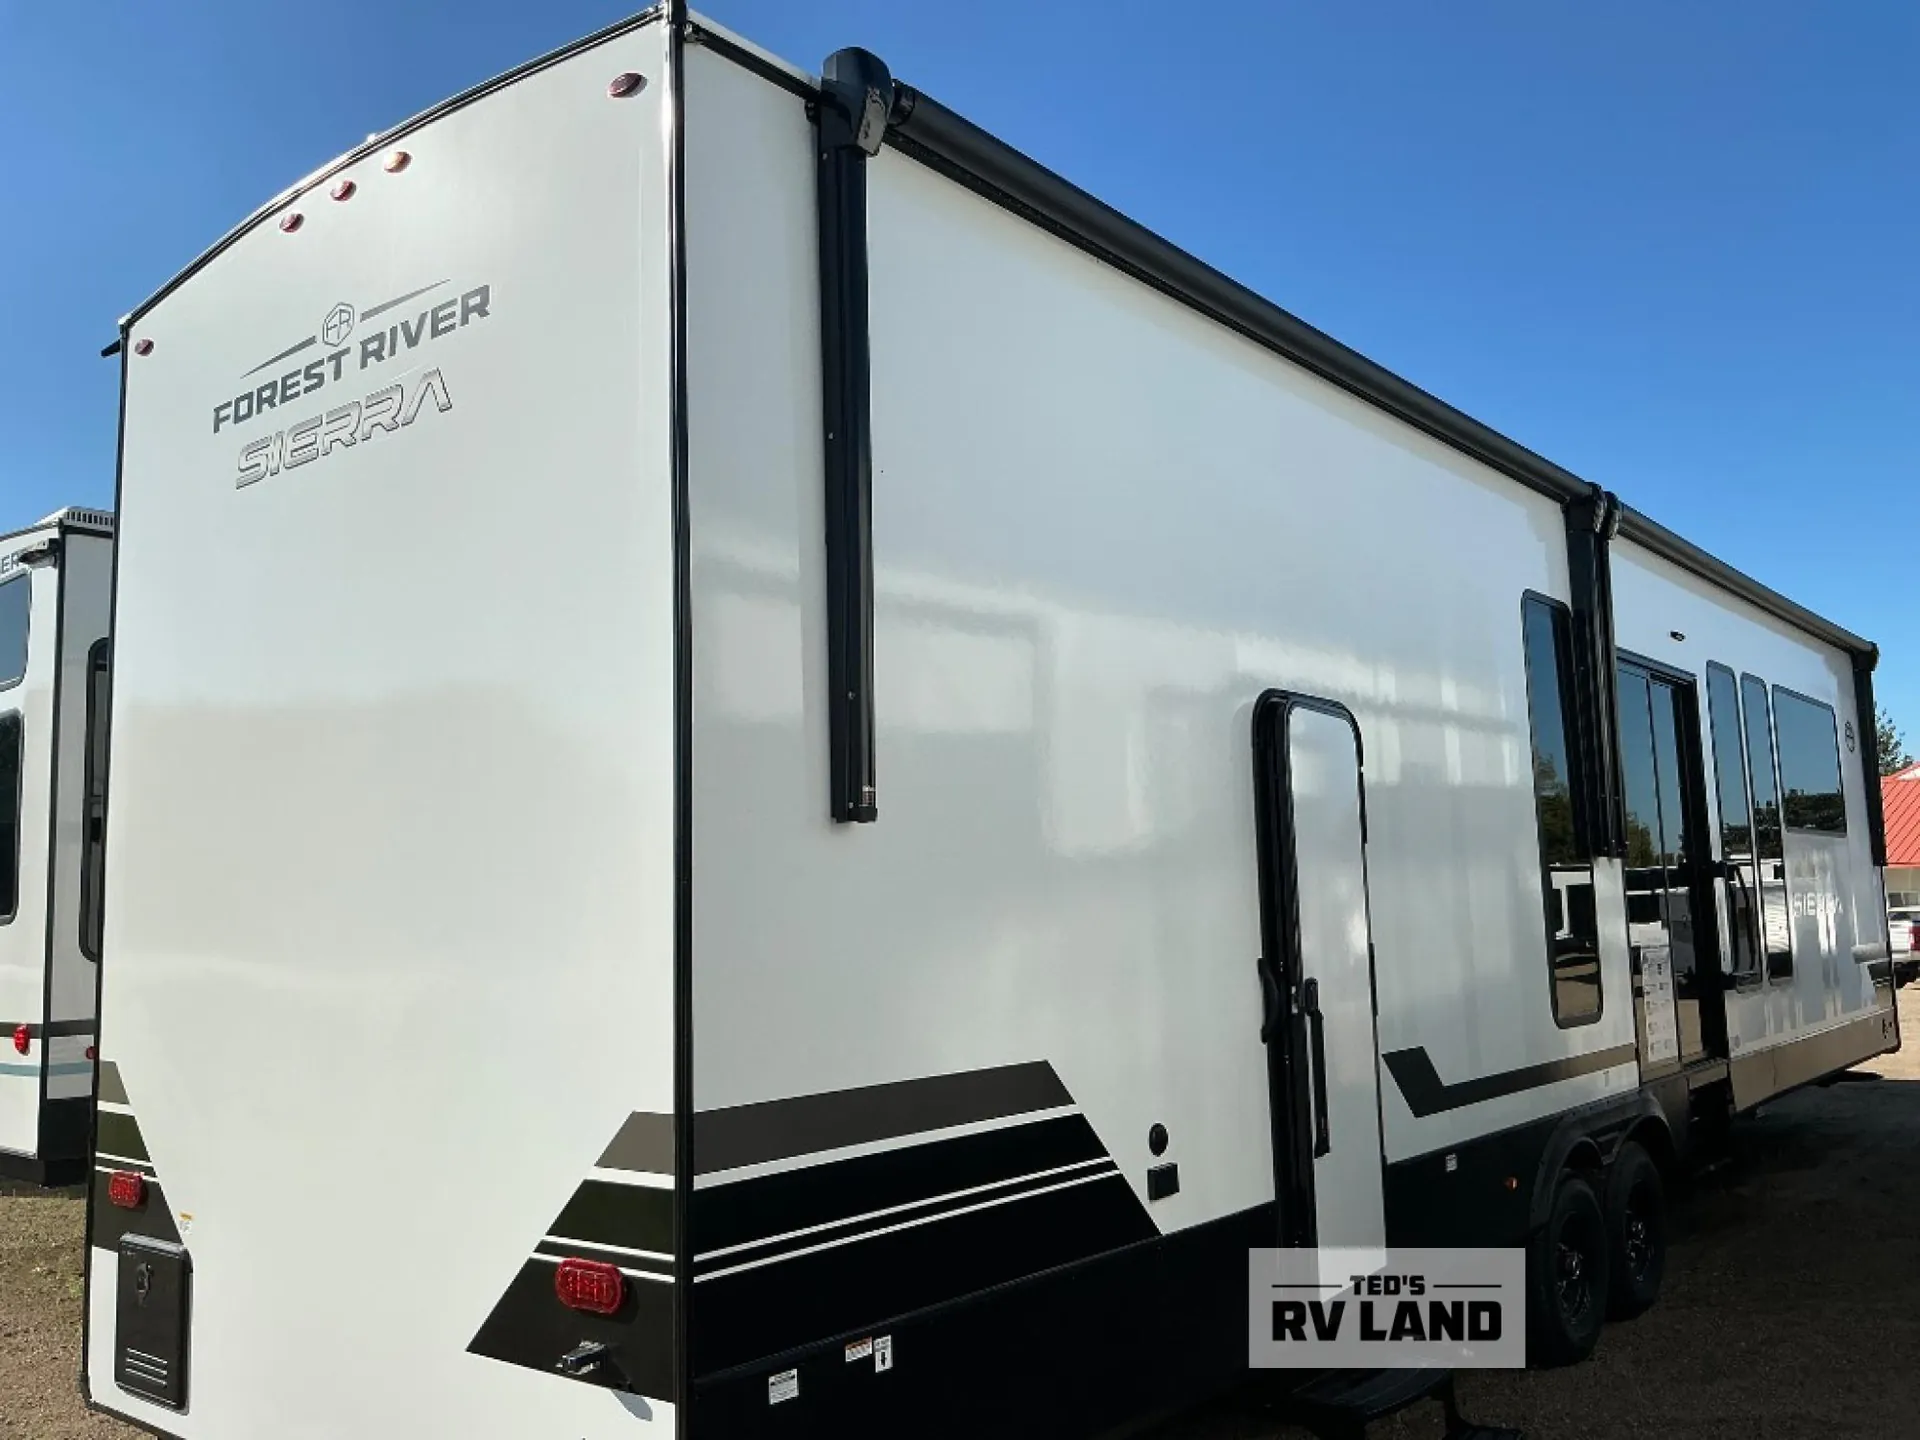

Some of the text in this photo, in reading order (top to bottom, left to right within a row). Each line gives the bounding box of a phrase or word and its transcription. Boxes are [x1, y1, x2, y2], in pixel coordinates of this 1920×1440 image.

[213, 284, 491, 434] FOREST RIVER
[236, 367, 452, 489] SIERRA
